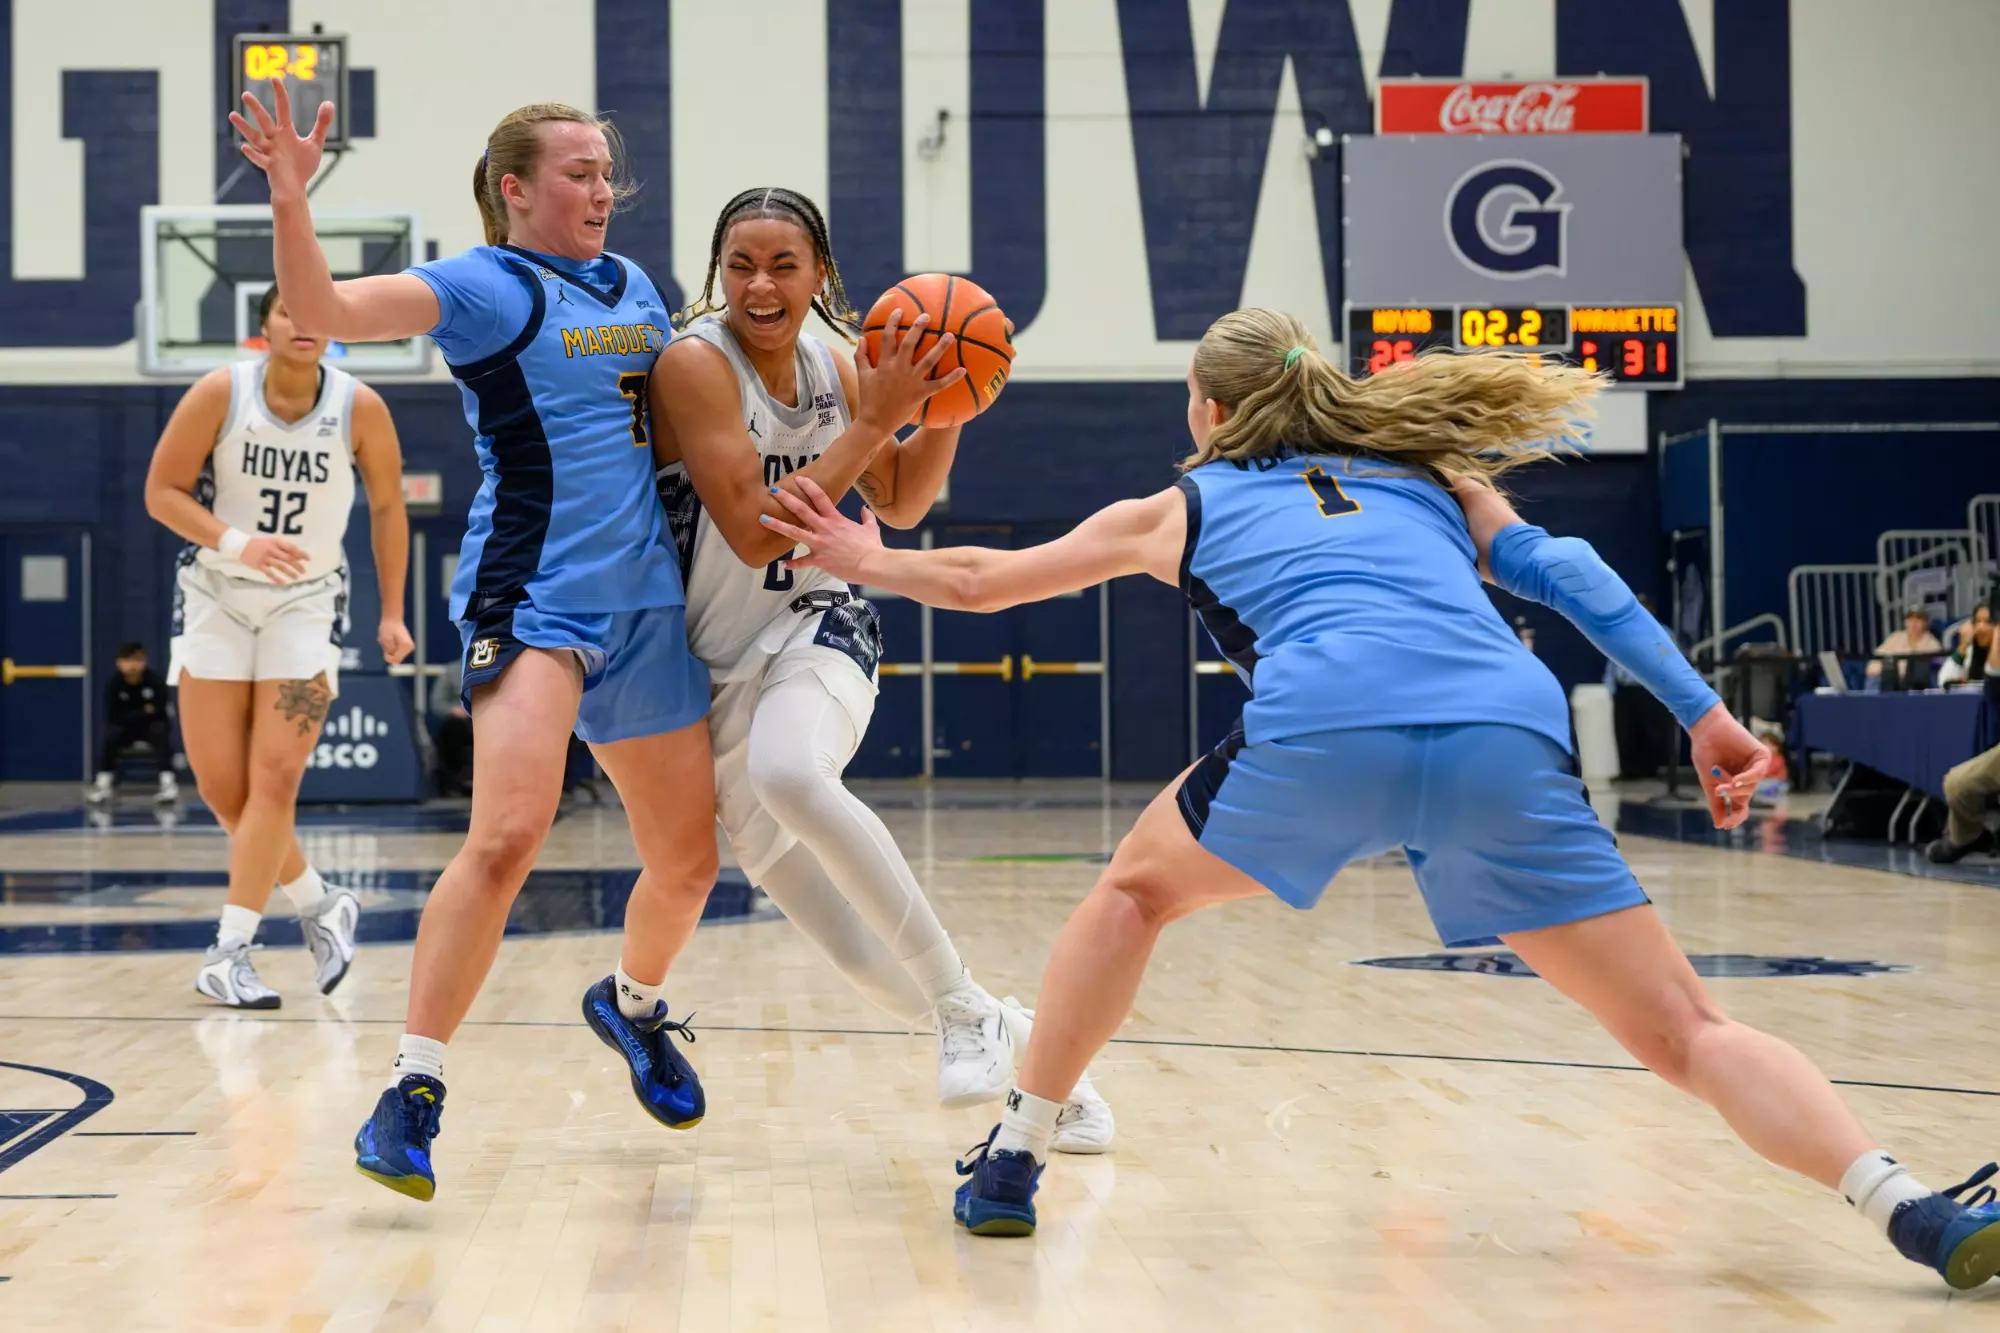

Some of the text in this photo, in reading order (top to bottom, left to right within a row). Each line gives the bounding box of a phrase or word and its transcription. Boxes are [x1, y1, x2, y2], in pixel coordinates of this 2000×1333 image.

[244, 44, 317, 80] 02.2
[1443, 157, 1573, 281] G
[1461, 309, 1542, 346] 02.2
[1623, 340, 1667, 376] 31
[815, 395, 824, 403] BE
[242, 442, 330, 483] HOYAS
[257, 488, 308, 535] 32
[1295, 465, 1363, 519] 1
